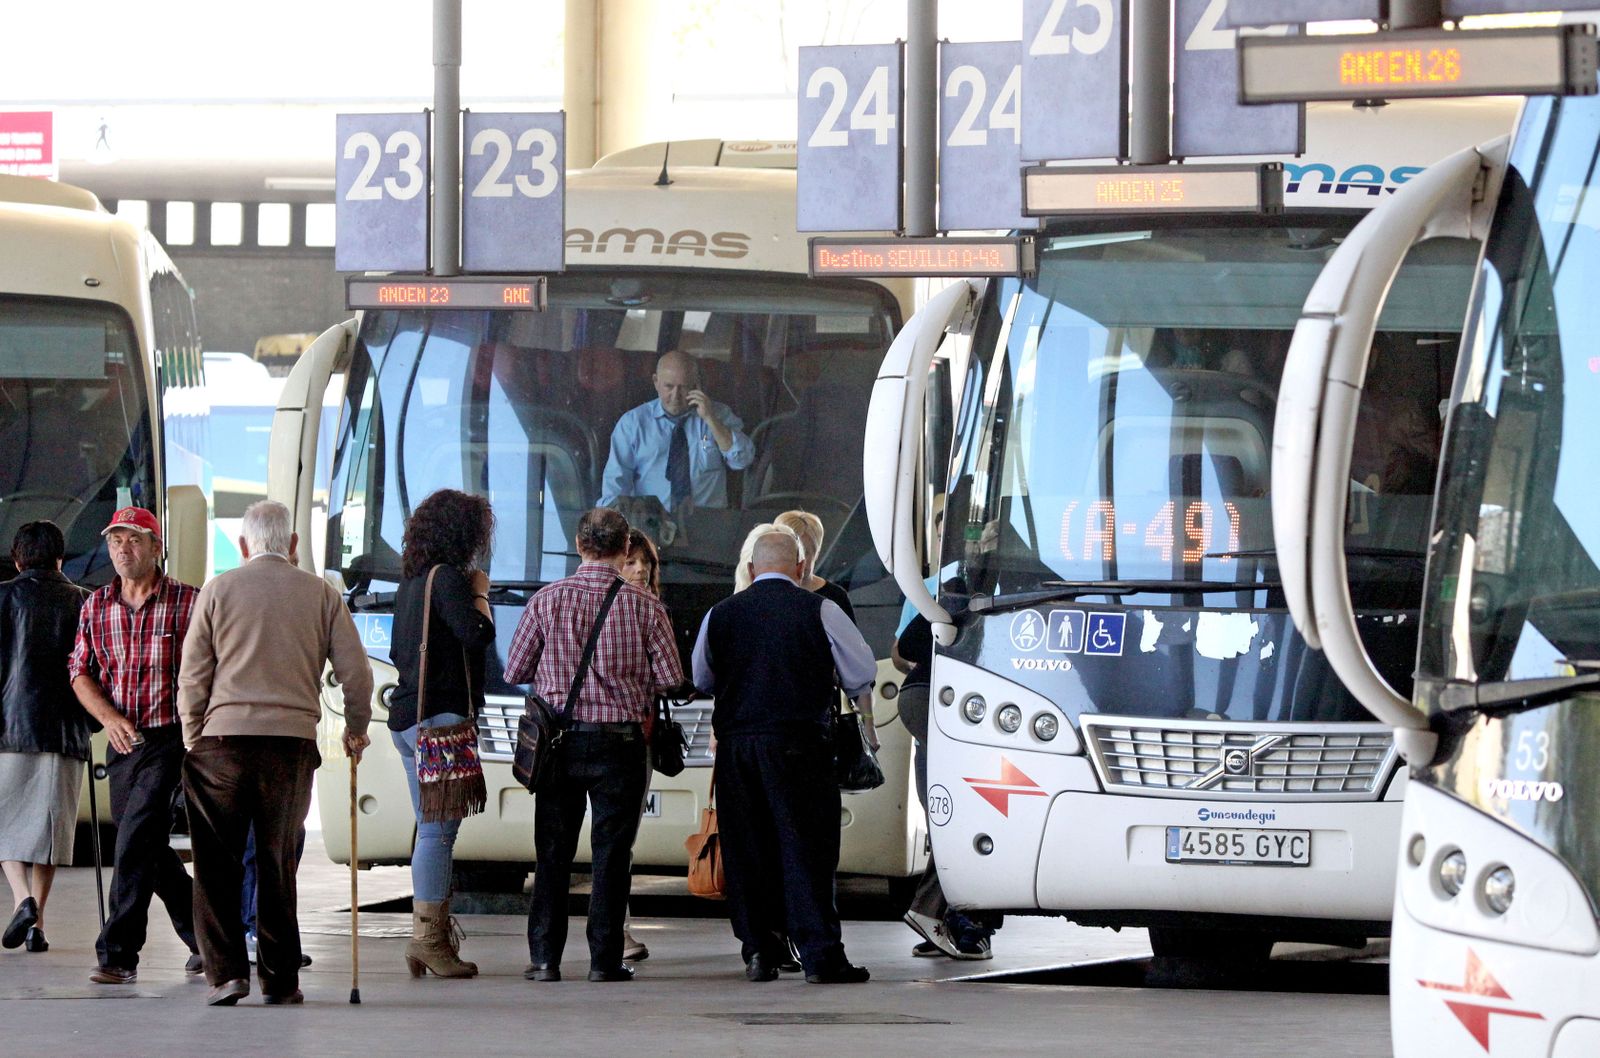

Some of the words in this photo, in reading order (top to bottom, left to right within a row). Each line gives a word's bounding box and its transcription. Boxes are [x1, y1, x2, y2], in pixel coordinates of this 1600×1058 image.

[806, 66, 896, 147] 24
[945, 64, 1022, 146] 24
[343, 130, 424, 200] 23
[470, 128, 559, 198] 23
[1096, 180, 1155, 202] ANDEN
[1160, 179, 1185, 201] 25
[819, 249, 884, 268] Destino
[887, 250, 958, 268] SEVILLA
[379, 286, 427, 304] ANDEN
[429, 287, 449, 303] 23
[1010, 658, 1073, 671] VOLVO
[1515, 730, 1550, 772] 53
[1483, 779, 1564, 802] VOLVO
[930, 796, 950, 815] 278
[1198, 808, 1276, 825] Sunsundegui
[1181, 831, 1245, 857] 4585
[1256, 834, 1304, 859] GYC
